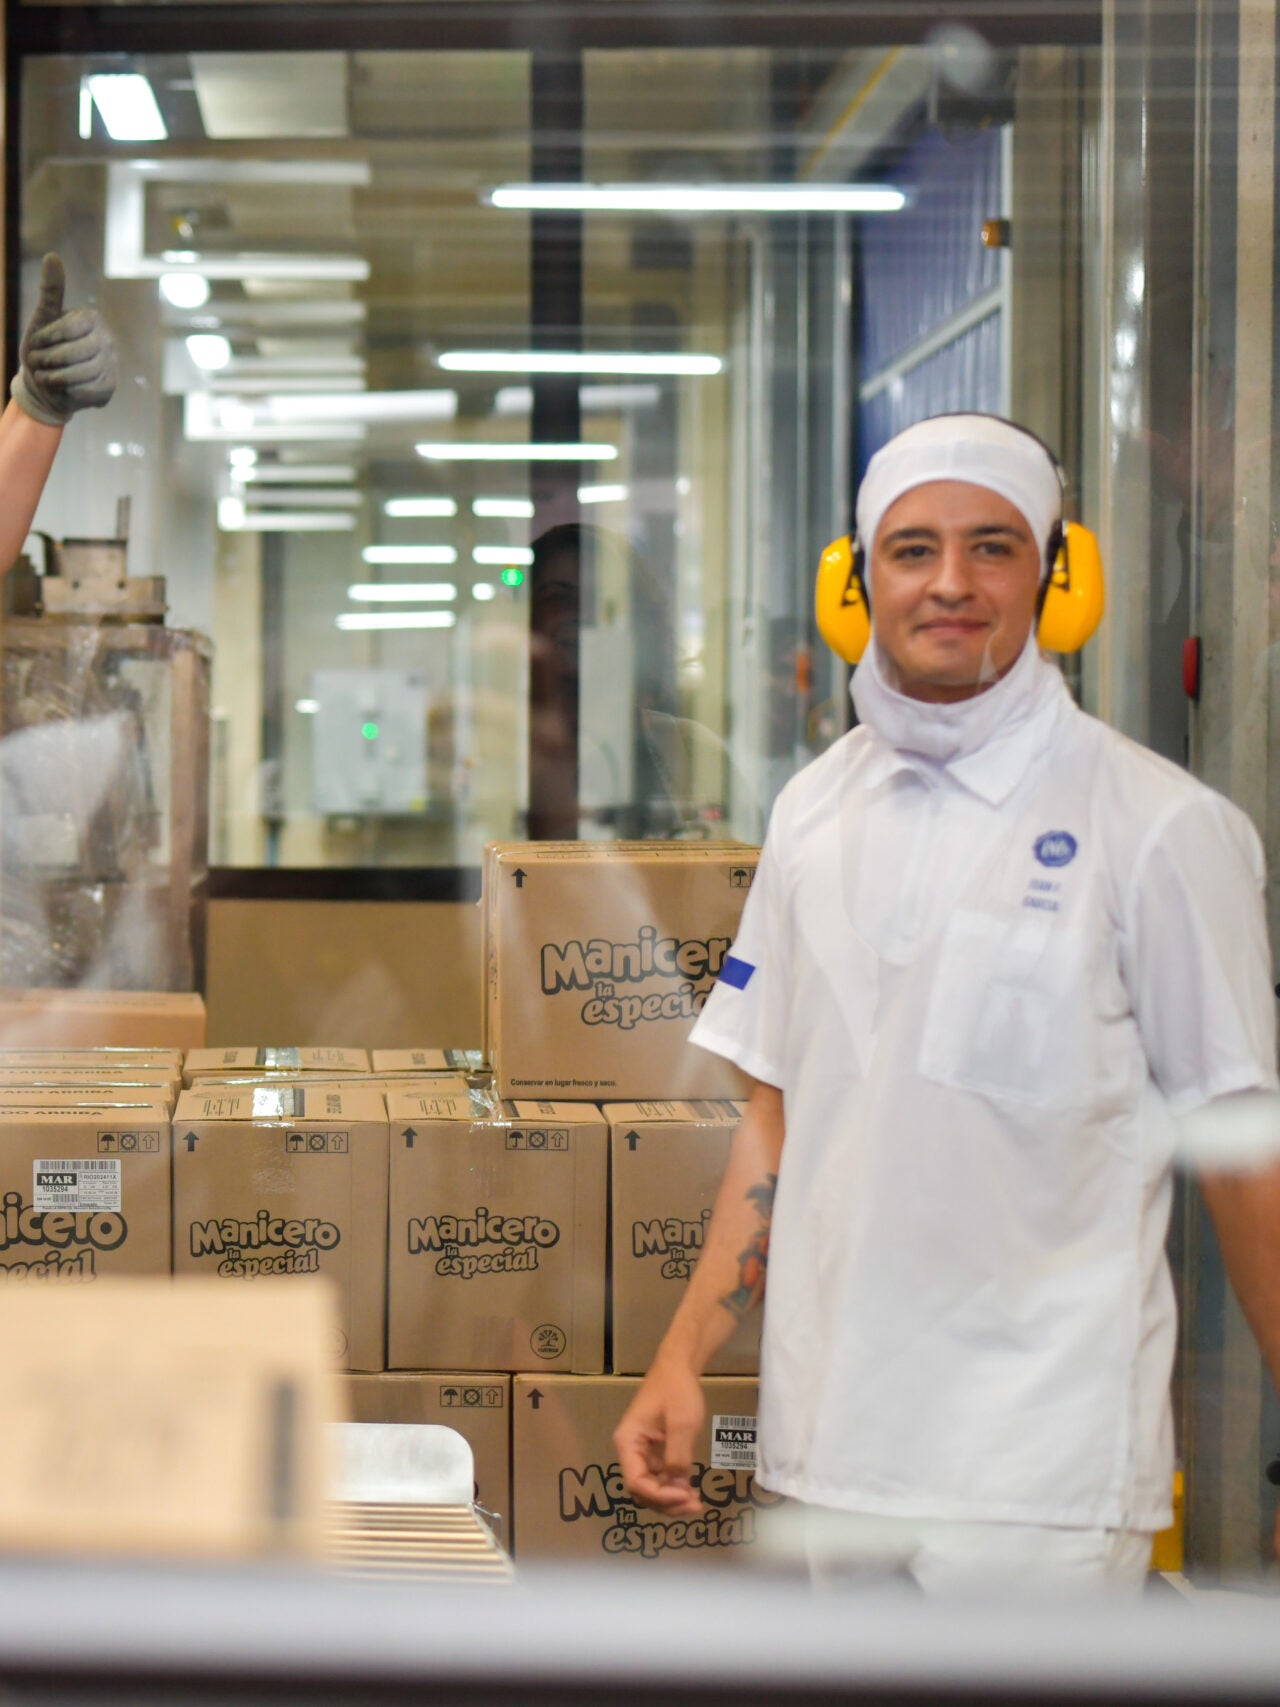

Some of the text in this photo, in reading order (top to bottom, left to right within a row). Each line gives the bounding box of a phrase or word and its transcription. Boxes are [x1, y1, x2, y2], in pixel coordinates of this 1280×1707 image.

[540, 925, 733, 995] Manicer
[595, 981, 615, 998] la
[581, 982, 715, 1030] especi
[510, 1078, 544, 1087] Conservar
[554, 1079, 571, 1088] lugar
[41, 1175, 73, 1184] MAR
[42, 1185, 69, 1193] 1035294
[190, 1209, 341, 1257] Manicero
[408, 1206, 560, 1254] Manicero
[632, 1208, 713, 1258] Mani
[227, 1248, 241, 1261] la
[445, 1245, 460, 1258] la
[671, 1247, 685, 1260] la
[218, 1248, 319, 1281] especial
[435, 1246, 539, 1280] especial
[720, 1431, 753, 1441] MAR
[617, 1507, 637, 1526] la
[602, 1506, 758, 1559] especial
